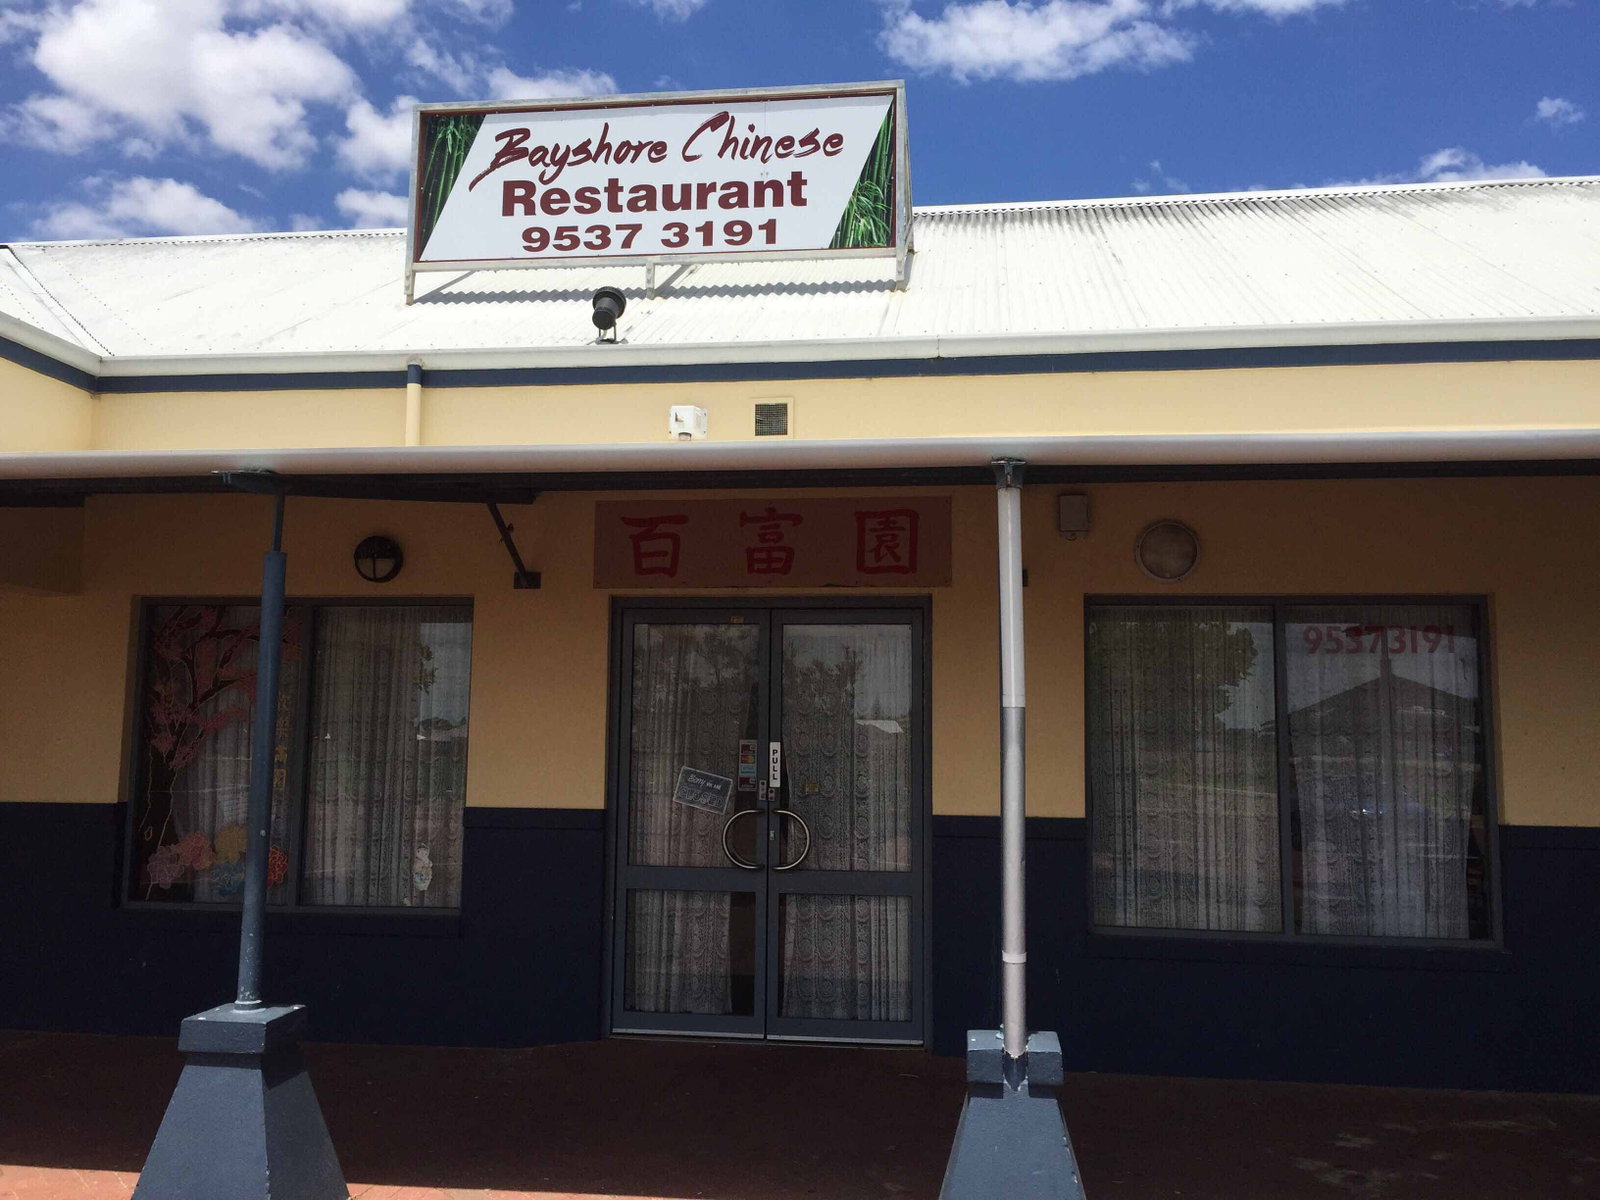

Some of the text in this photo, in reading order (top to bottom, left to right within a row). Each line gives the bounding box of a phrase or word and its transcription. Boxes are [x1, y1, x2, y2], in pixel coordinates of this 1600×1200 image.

[468, 111, 844, 192] Bayshore Chinese
[502, 171, 807, 217] Restaurant
[522, 219, 777, 252] 9537 3191
[620, 507, 920, 578] 百富園
